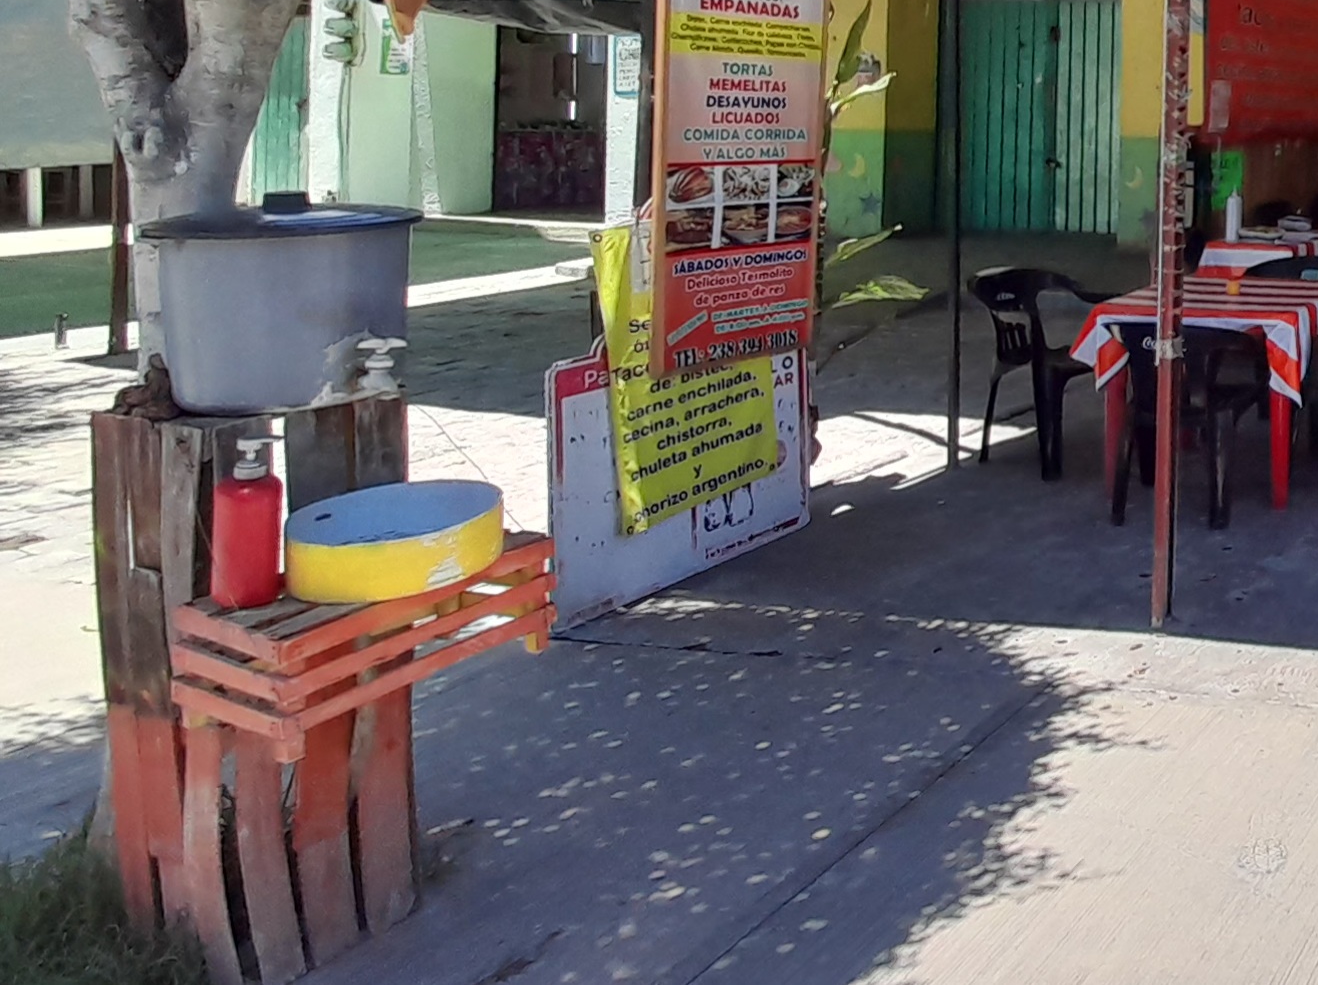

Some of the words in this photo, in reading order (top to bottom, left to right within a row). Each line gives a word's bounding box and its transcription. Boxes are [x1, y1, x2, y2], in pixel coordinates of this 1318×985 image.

[722, 62, 773, 76] TORTAS
[709, 78, 786, 92] MEMELITAS
[706, 95, 787, 109] DESAYUNOS
[712, 112, 780, 125] LICUADOS
[683, 128, 740, 141] COMIDA
[744, 128, 807, 141] CORRIDA
[703, 148, 712, 159] Y
[716, 147, 756, 159] ALGO
[733, 256, 742, 267] Y
[744, 249, 806, 266] DOMINGOS
[687, 276, 737, 290] Delicioso
[741, 269, 793, 282] Tesmolito
[695, 294, 709, 306] de
[713, 292, 748, 305] panza
[752, 287, 766, 296] de
[769, 285, 785, 294] res
[709, 341, 736, 361] 238
[767, 329, 797, 350] 3018
[623, 417, 680, 444] cecina,
[684, 387, 765, 422] arrachera,
[627, 398, 674, 422] carne
[656, 416, 732, 450] chistorra,
[630, 451, 687, 481] chuleta
[691, 422, 763, 457] ahumada
[692, 464, 702, 479] y
